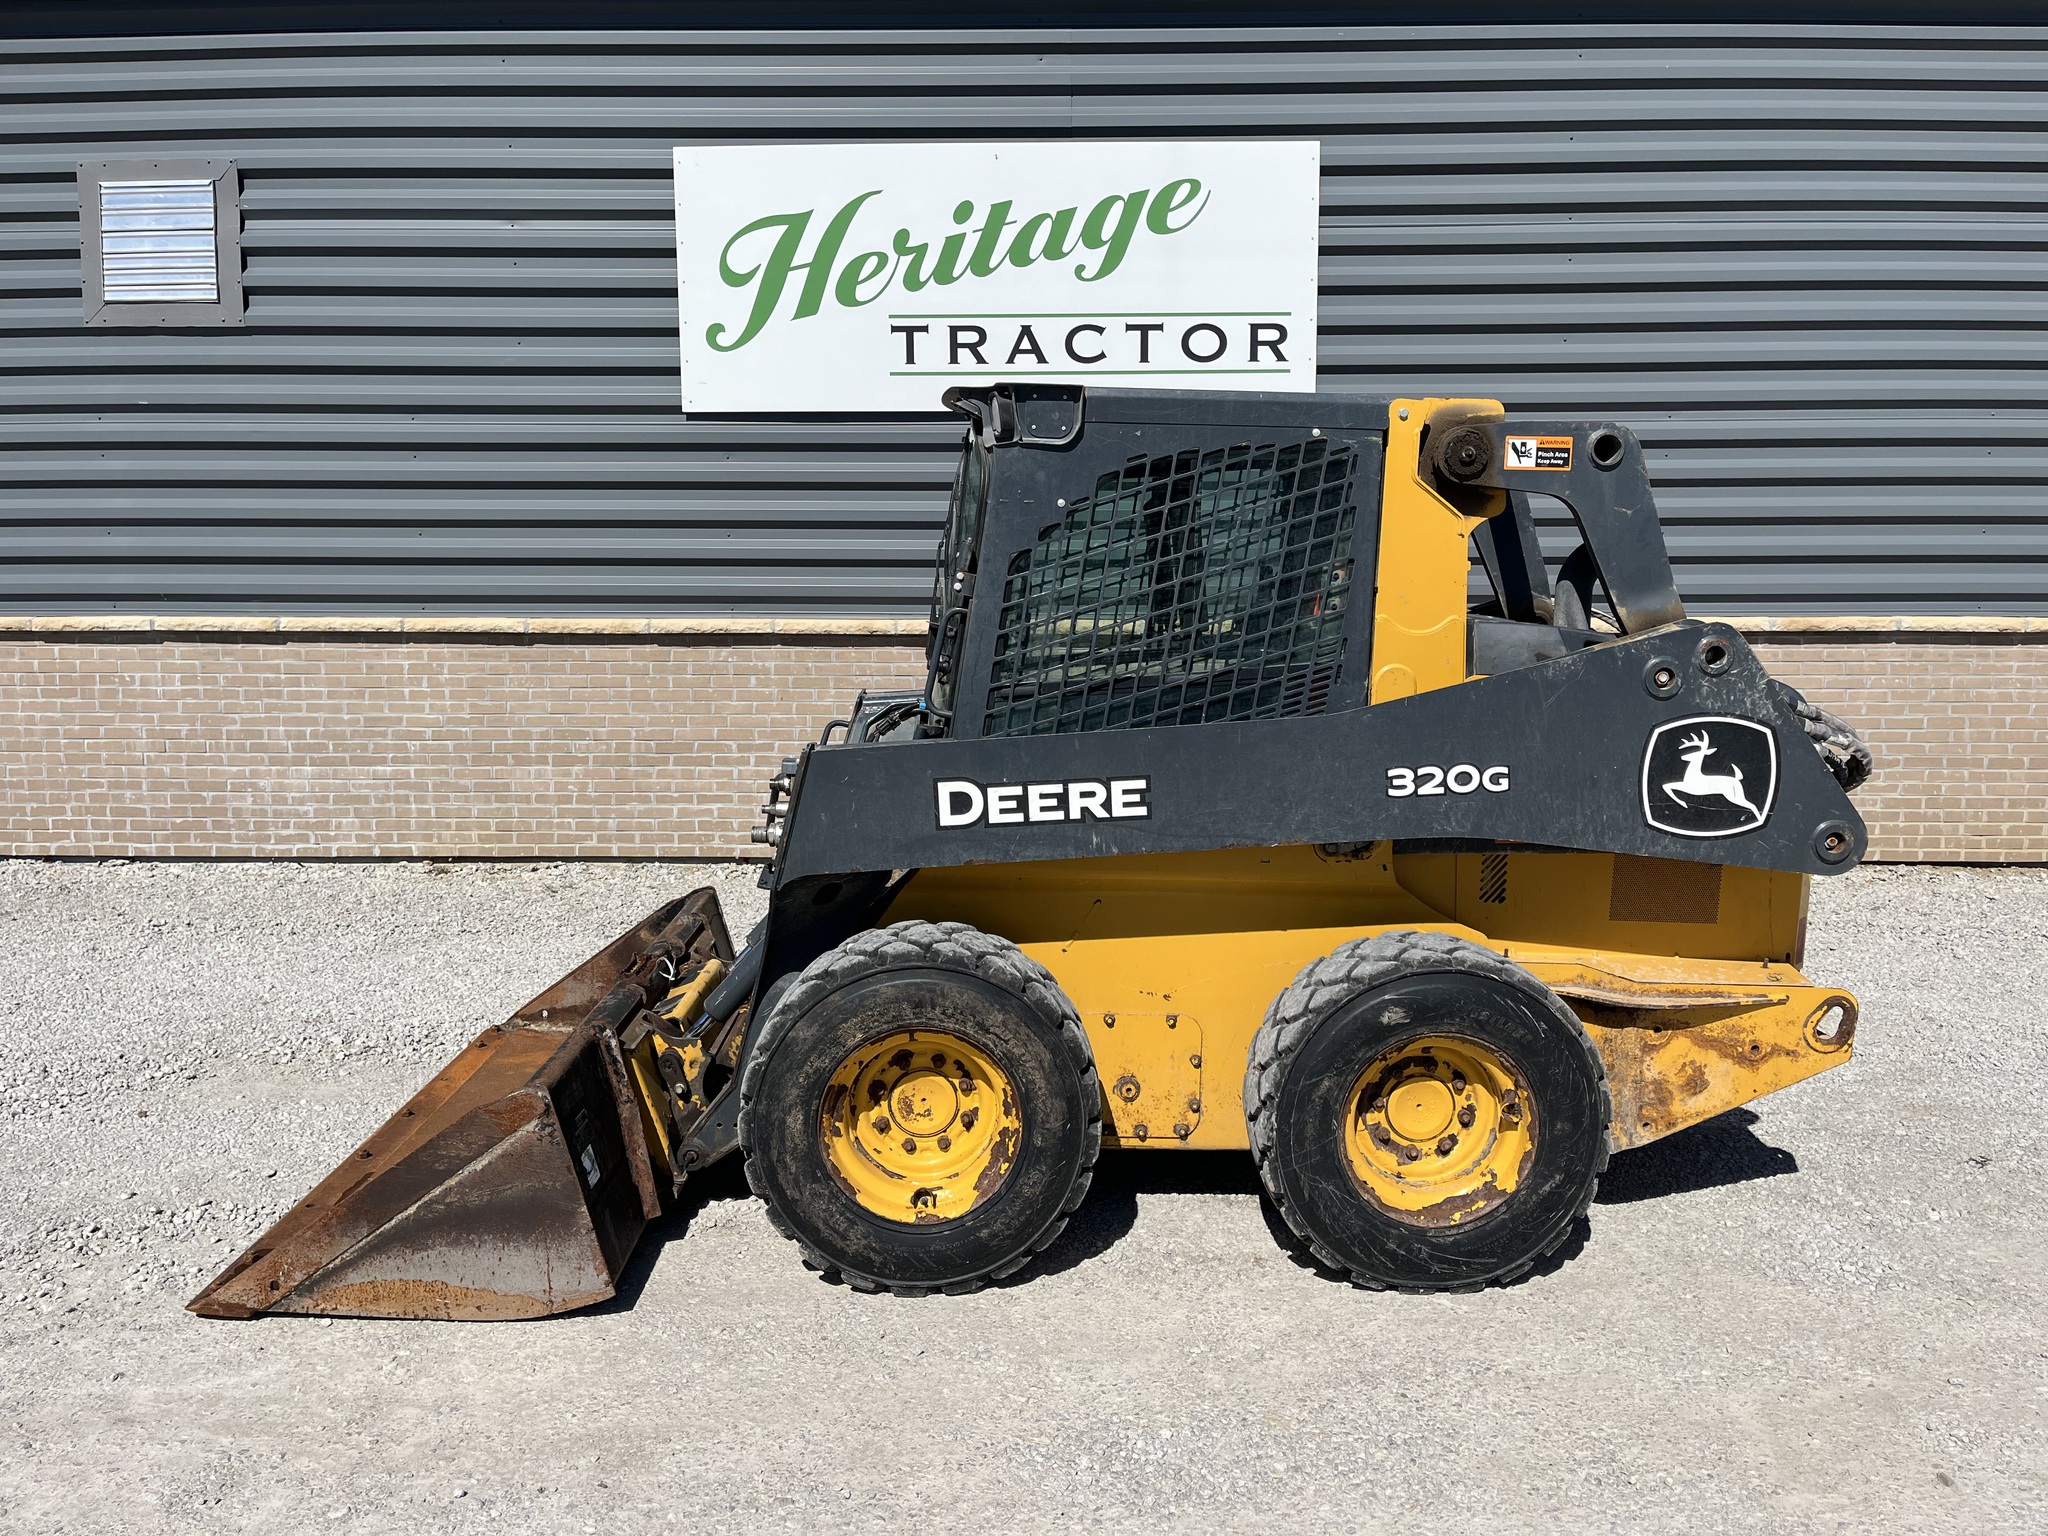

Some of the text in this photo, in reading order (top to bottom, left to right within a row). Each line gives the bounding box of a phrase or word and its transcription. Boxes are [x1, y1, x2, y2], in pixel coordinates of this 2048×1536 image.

[706, 178, 1212, 352] Heritage
[889, 322, 1290, 365] TRACTOR
[937, 779, 1148, 827] DEERE
[1387, 764, 1510, 797] 320G
